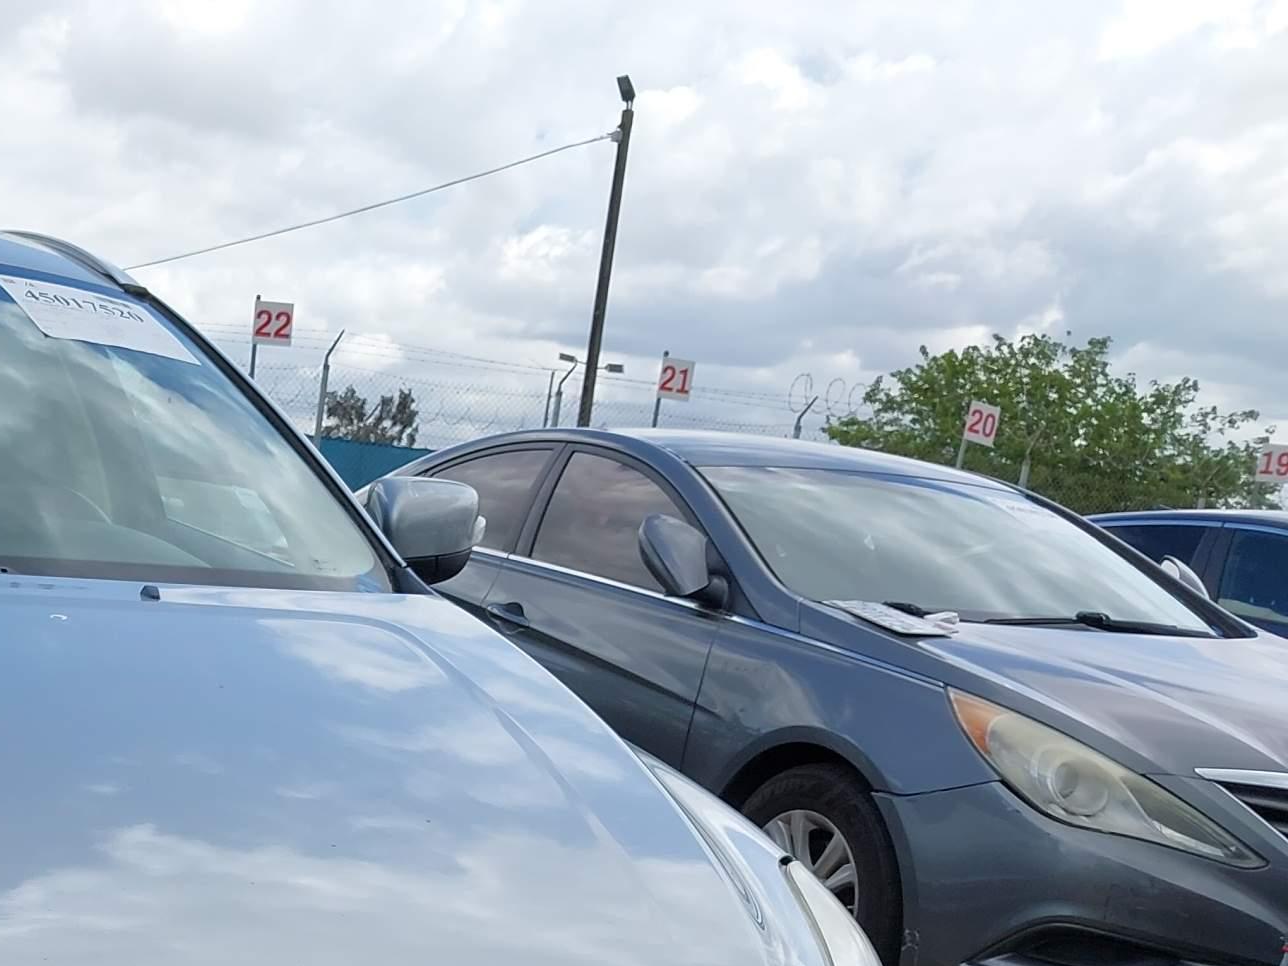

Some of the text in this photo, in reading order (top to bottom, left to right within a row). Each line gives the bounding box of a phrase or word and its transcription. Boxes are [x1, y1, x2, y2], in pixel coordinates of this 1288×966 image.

[24, 289, 144, 323] 45017520
[255, 310, 291, 339] 22
[660, 365, 689, 394] 21
[968, 409, 996, 437] 20
[1259, 451, 1288, 476] 19
